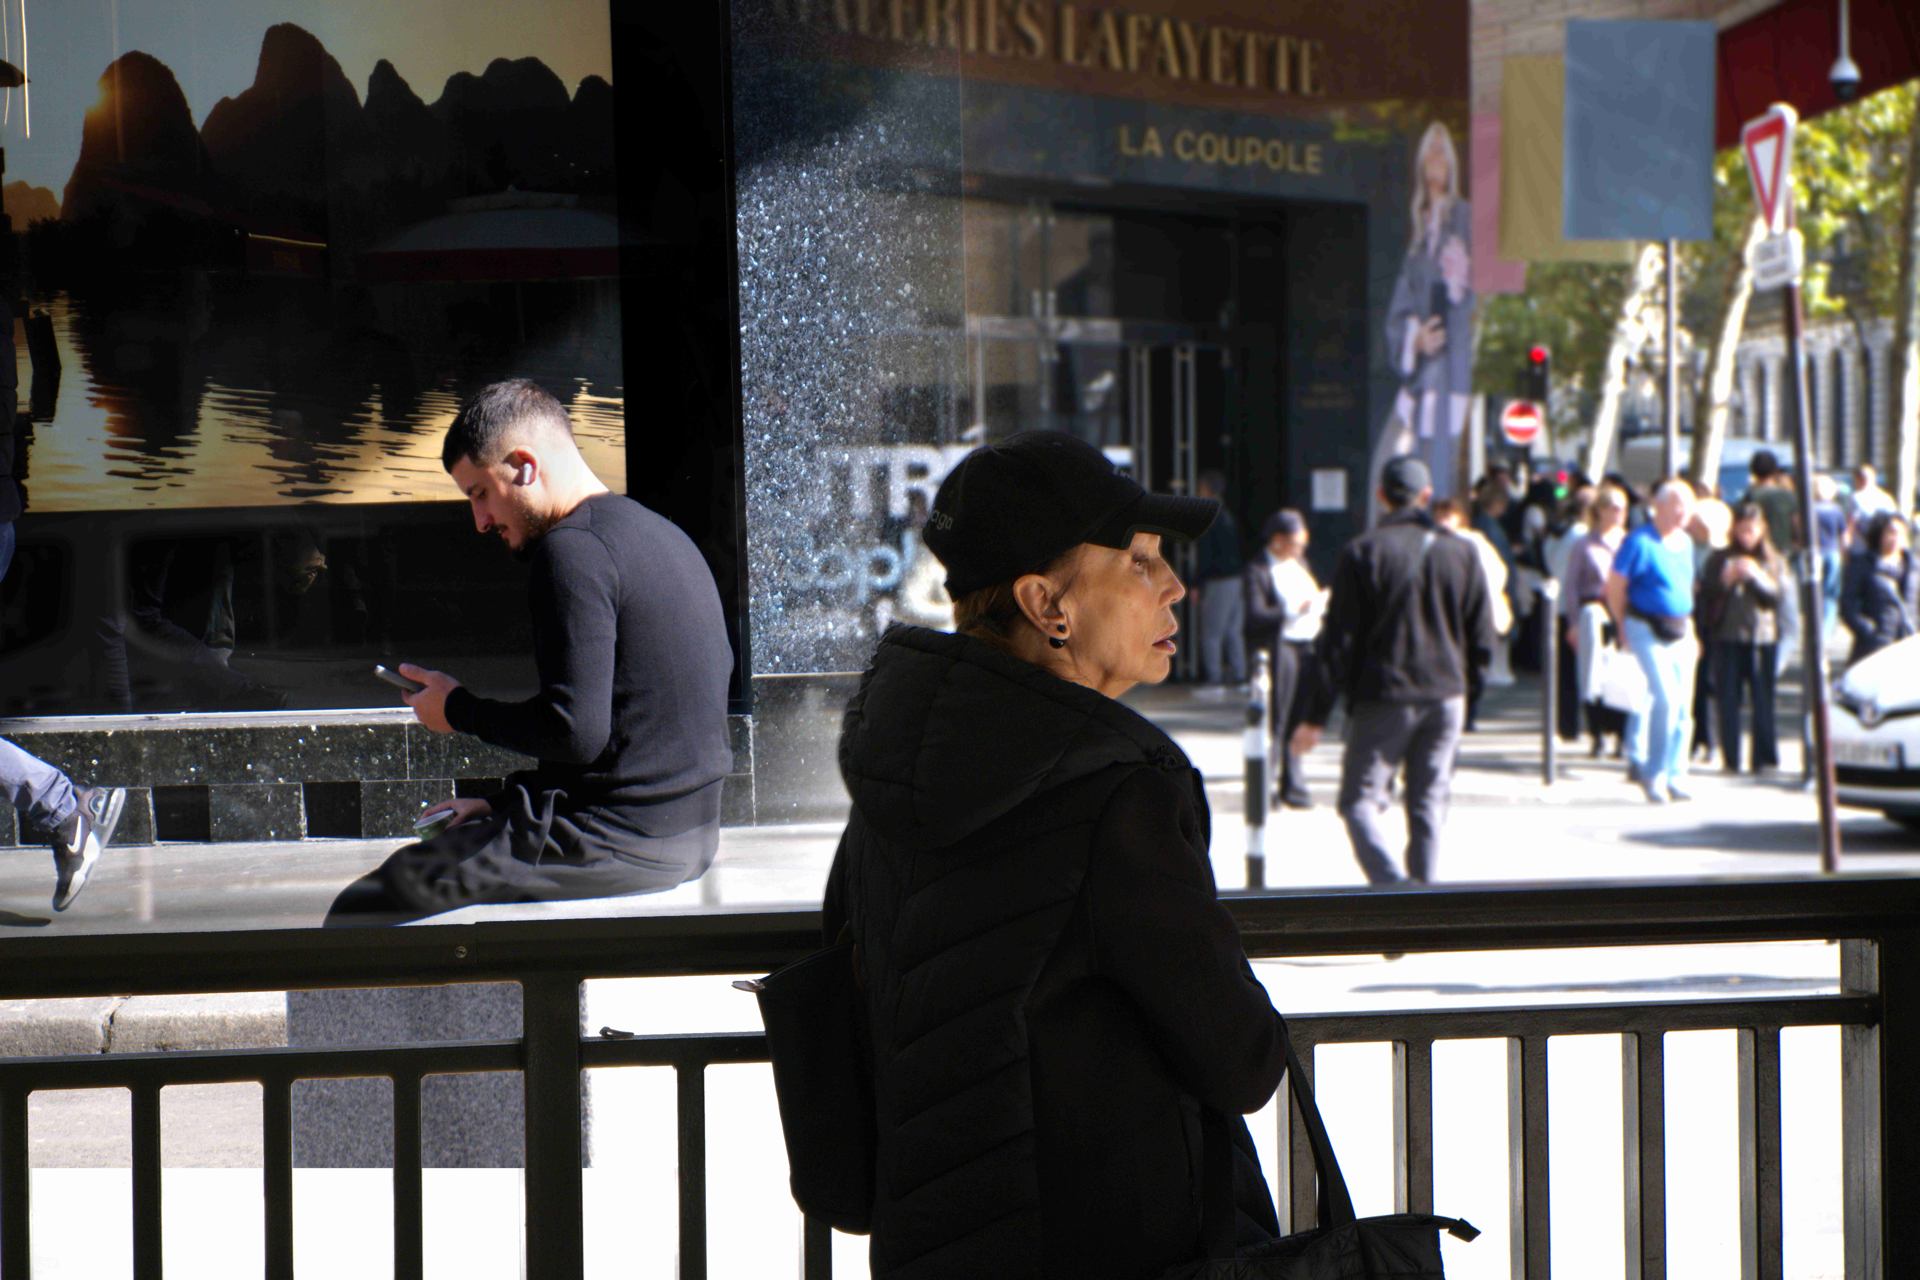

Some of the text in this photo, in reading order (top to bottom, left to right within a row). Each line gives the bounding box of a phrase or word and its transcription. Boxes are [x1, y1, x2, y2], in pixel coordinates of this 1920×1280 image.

[1060, 4, 1326, 96] LAFAYETTE
[1119, 125, 1325, 175] LA COUPOLE
